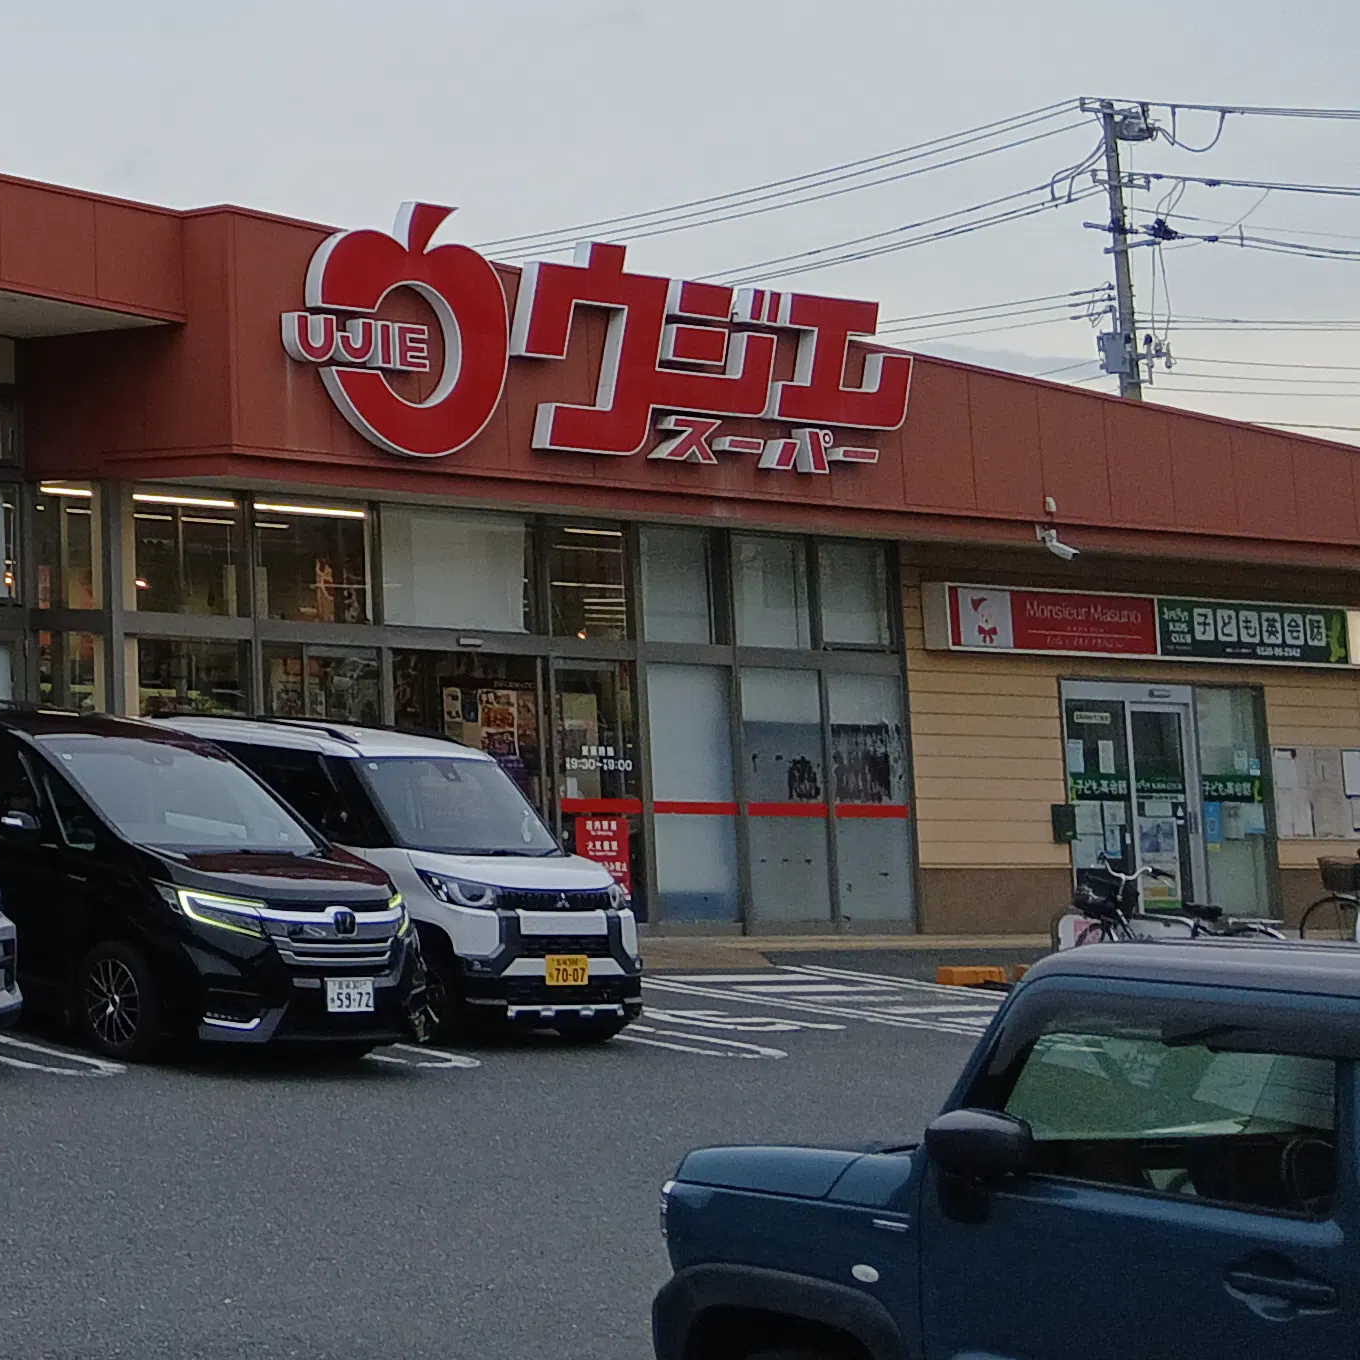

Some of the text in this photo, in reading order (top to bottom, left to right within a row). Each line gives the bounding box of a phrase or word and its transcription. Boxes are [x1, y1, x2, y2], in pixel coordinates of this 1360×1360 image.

[281, 311, 430, 373] UJIE
[510, 241, 913, 455] ウジエ
[647, 415, 880, 474] スーパー
[1025, 599, 1089, 620] Monsieur
[1195, 611, 1326, 643] 子ども英会話
[1075, 779, 1128, 795] 子ども英会話
[1202, 780, 1252, 797] 子ども英会話
[555, 967, 586, 983] 70-07
[336, 991, 373, 1009] 59-72
